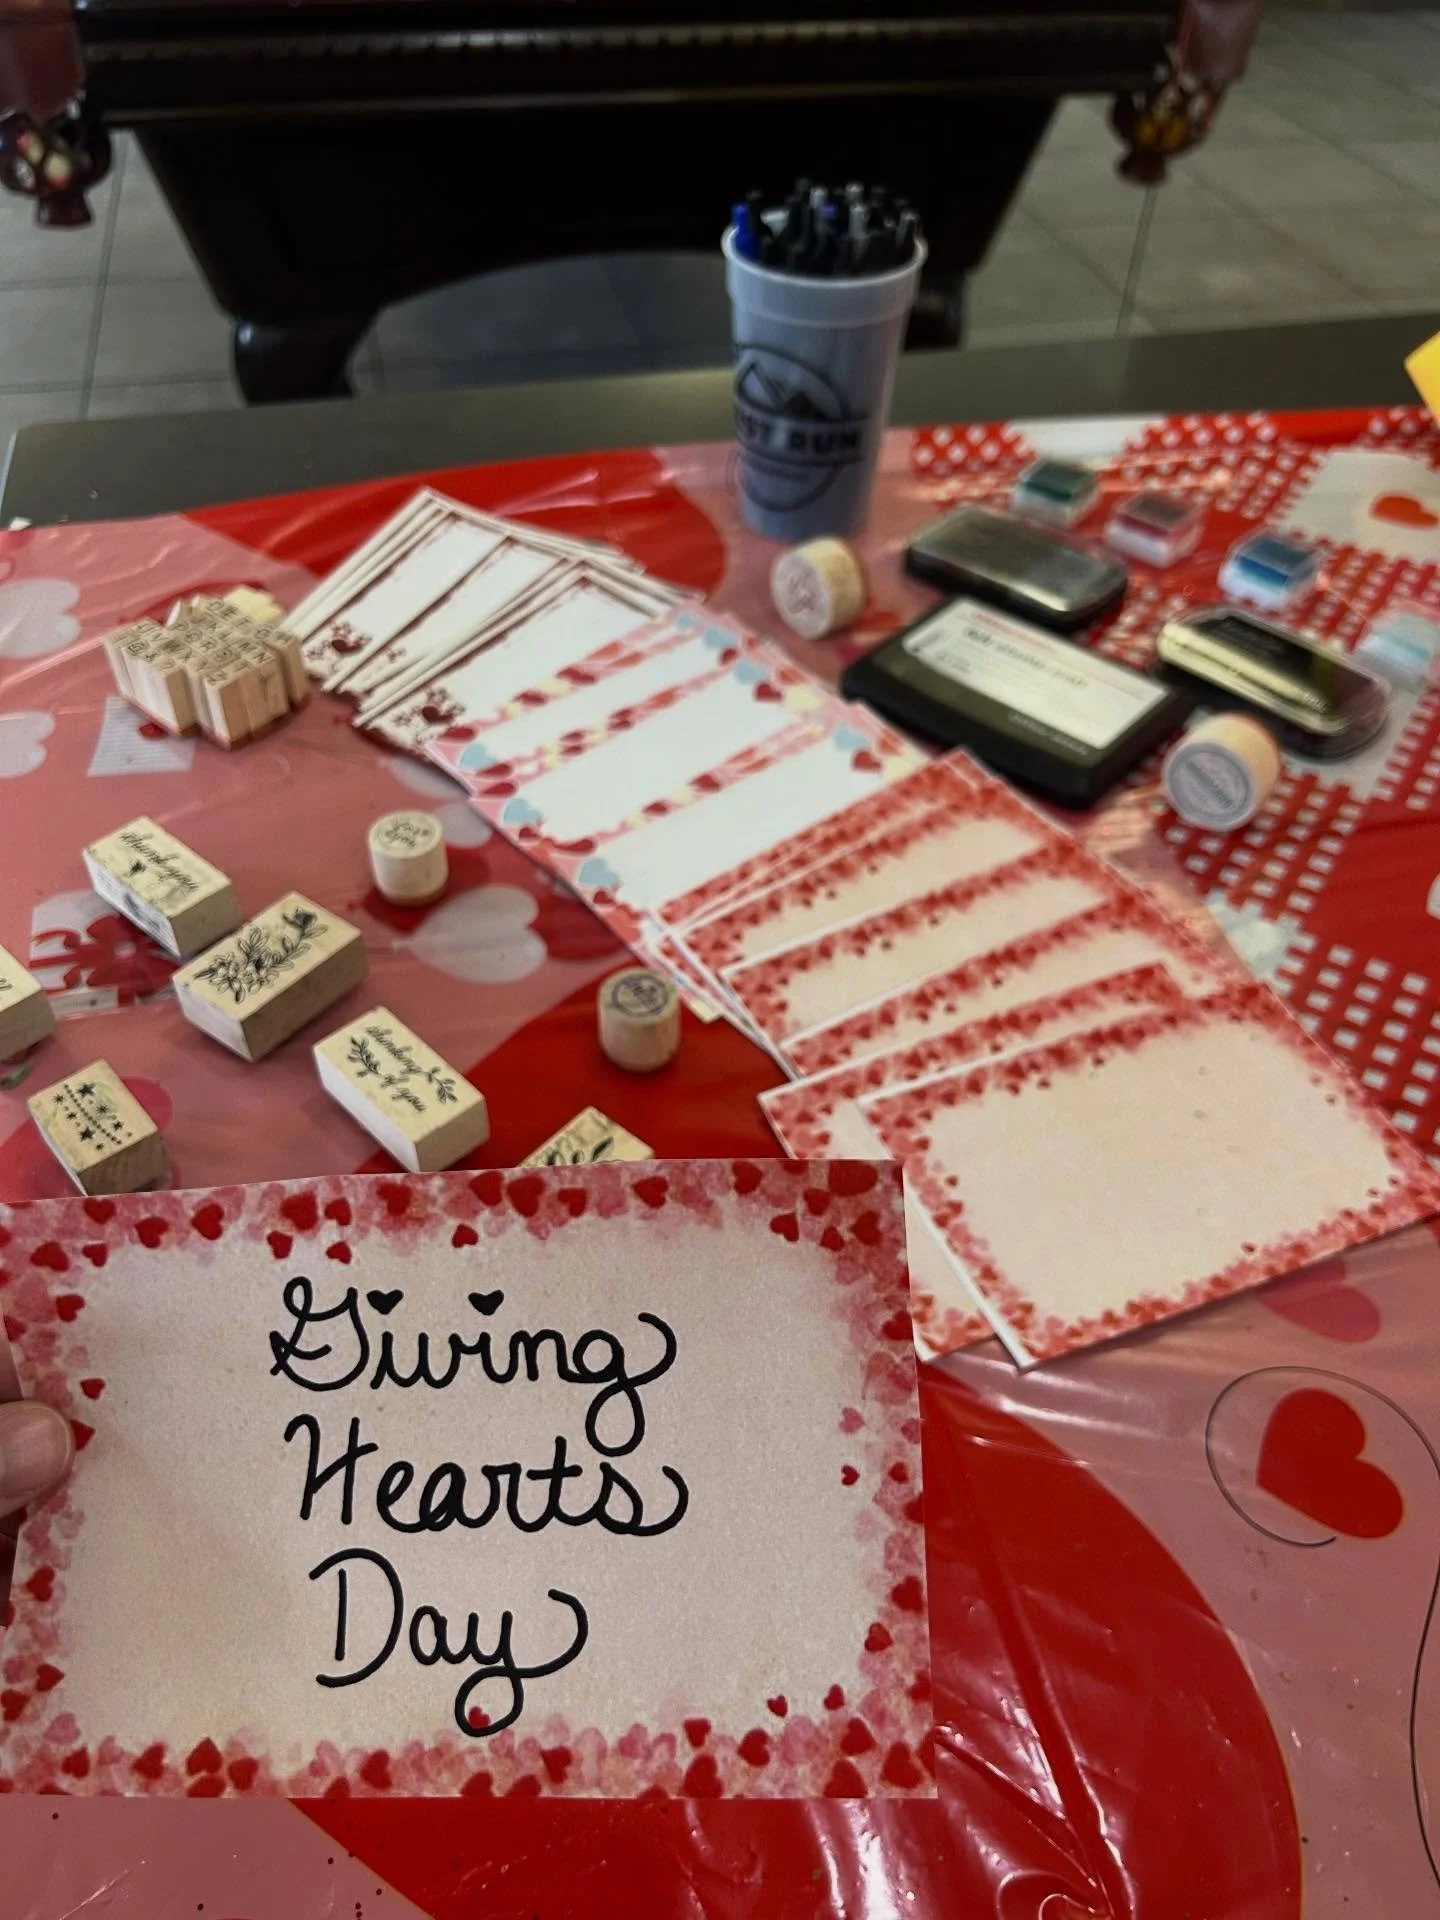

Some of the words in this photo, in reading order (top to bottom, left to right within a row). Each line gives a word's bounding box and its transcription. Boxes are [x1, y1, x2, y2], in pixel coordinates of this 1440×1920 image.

[268, 1275, 678, 1458] Giving
[283, 1412, 690, 1537] Hearts
[308, 1546, 590, 1738] Day
